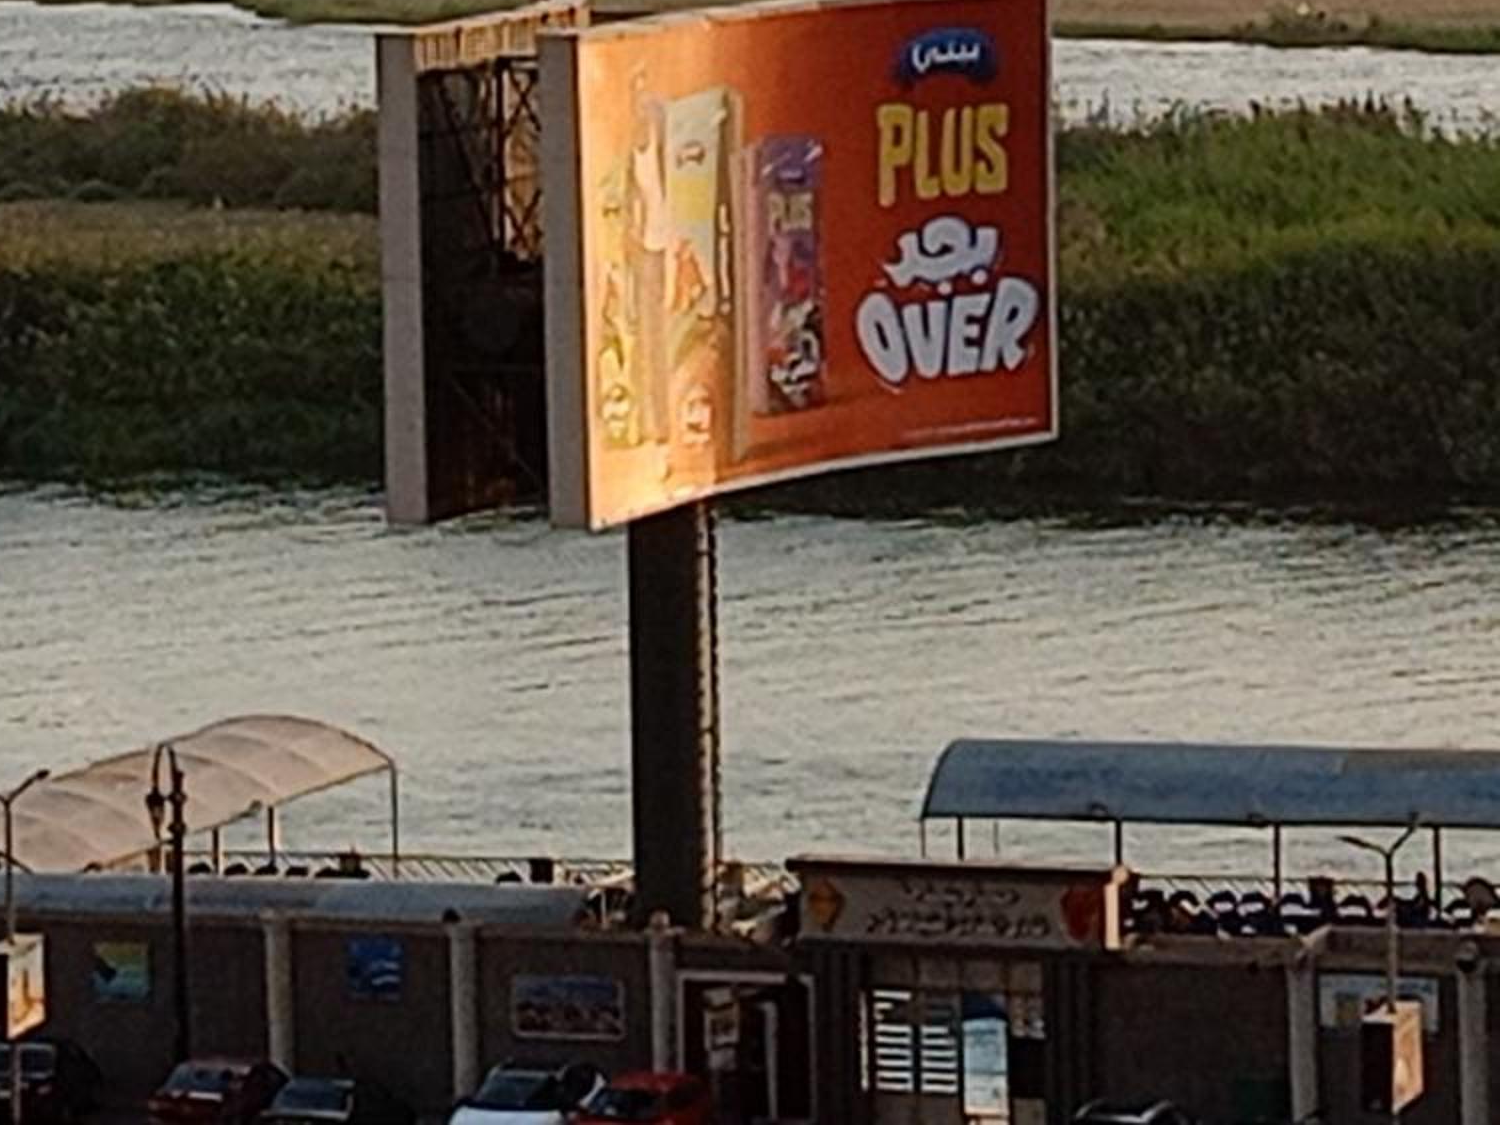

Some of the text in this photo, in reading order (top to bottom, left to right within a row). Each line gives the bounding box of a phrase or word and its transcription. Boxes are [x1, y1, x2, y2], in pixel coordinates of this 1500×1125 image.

[877, 105, 1009, 207] PLUS
[883, 217, 1000, 295] بجد
[857, 278, 1039, 382] OVER
